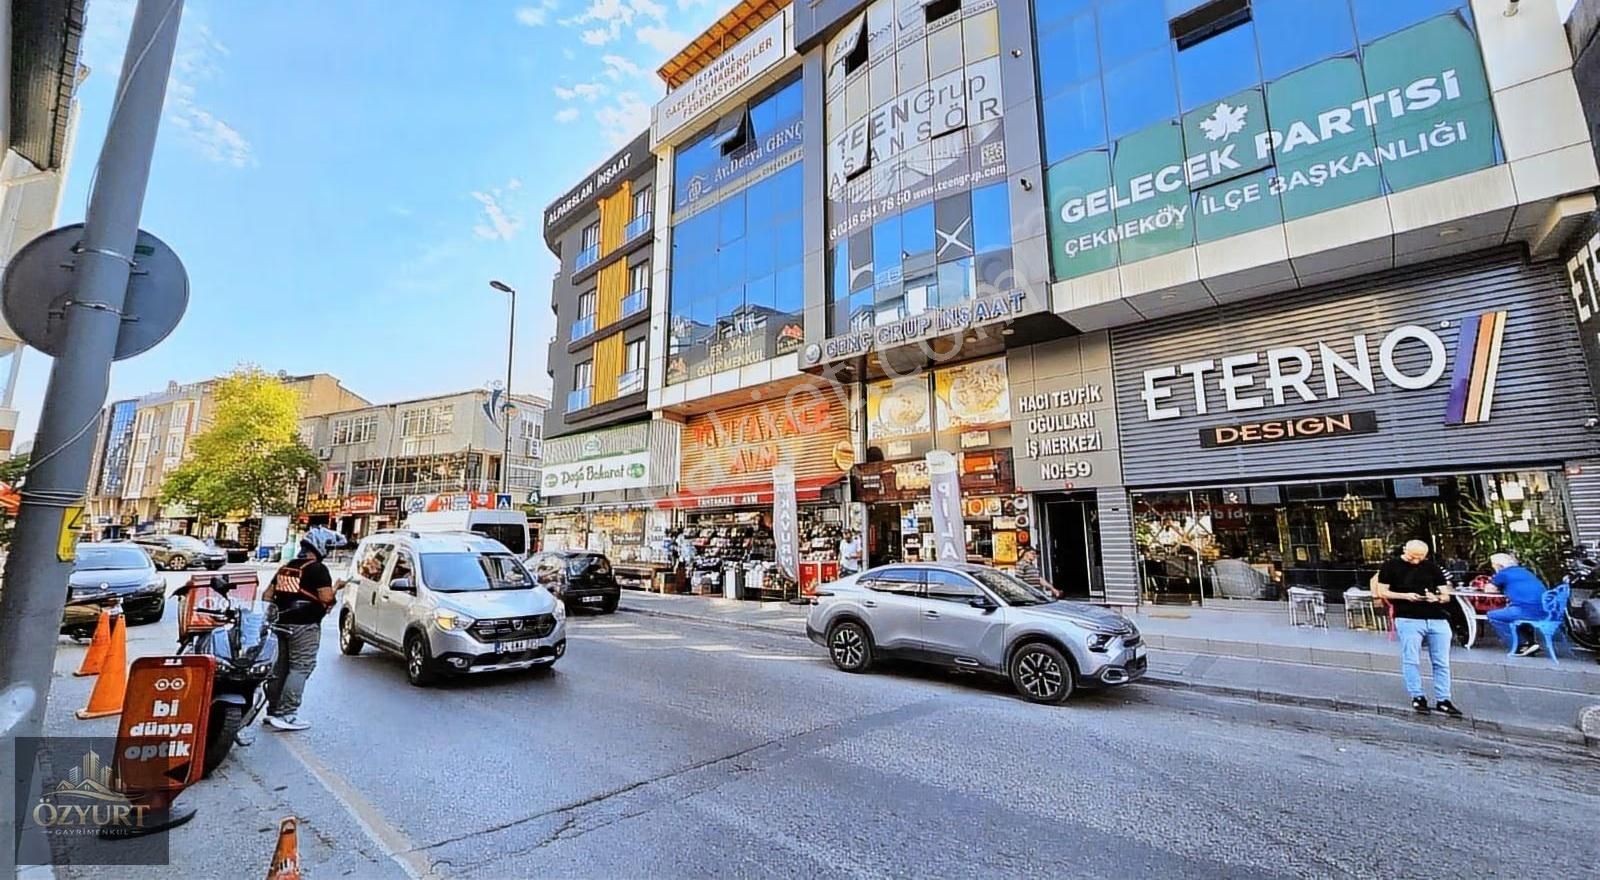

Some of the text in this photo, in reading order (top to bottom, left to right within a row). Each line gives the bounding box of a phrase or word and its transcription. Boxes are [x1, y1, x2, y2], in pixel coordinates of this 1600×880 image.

[1060, 68, 1461, 225] GELECEK PARTİSİ
[548, 182, 593, 226] ALPARSLAN
[1064, 121, 1468, 258] ÇEKMEKÖY İLÇE BAŞKANLIĞI
[1141, 325, 1447, 421] ETERNO
[1019, 384, 1102, 413] HACI TEVFİK
[1028, 411, 1095, 434] OĞULLARI
[1215, 413, 1352, 444] DESIGN
[1025, 430, 1102, 460] İŞ MERKEZİ
[1041, 460, 1092, 480] NO:59
[153, 699, 180, 717] bi
[129, 721, 194, 738] dünya
[124, 740, 192, 762] optik
